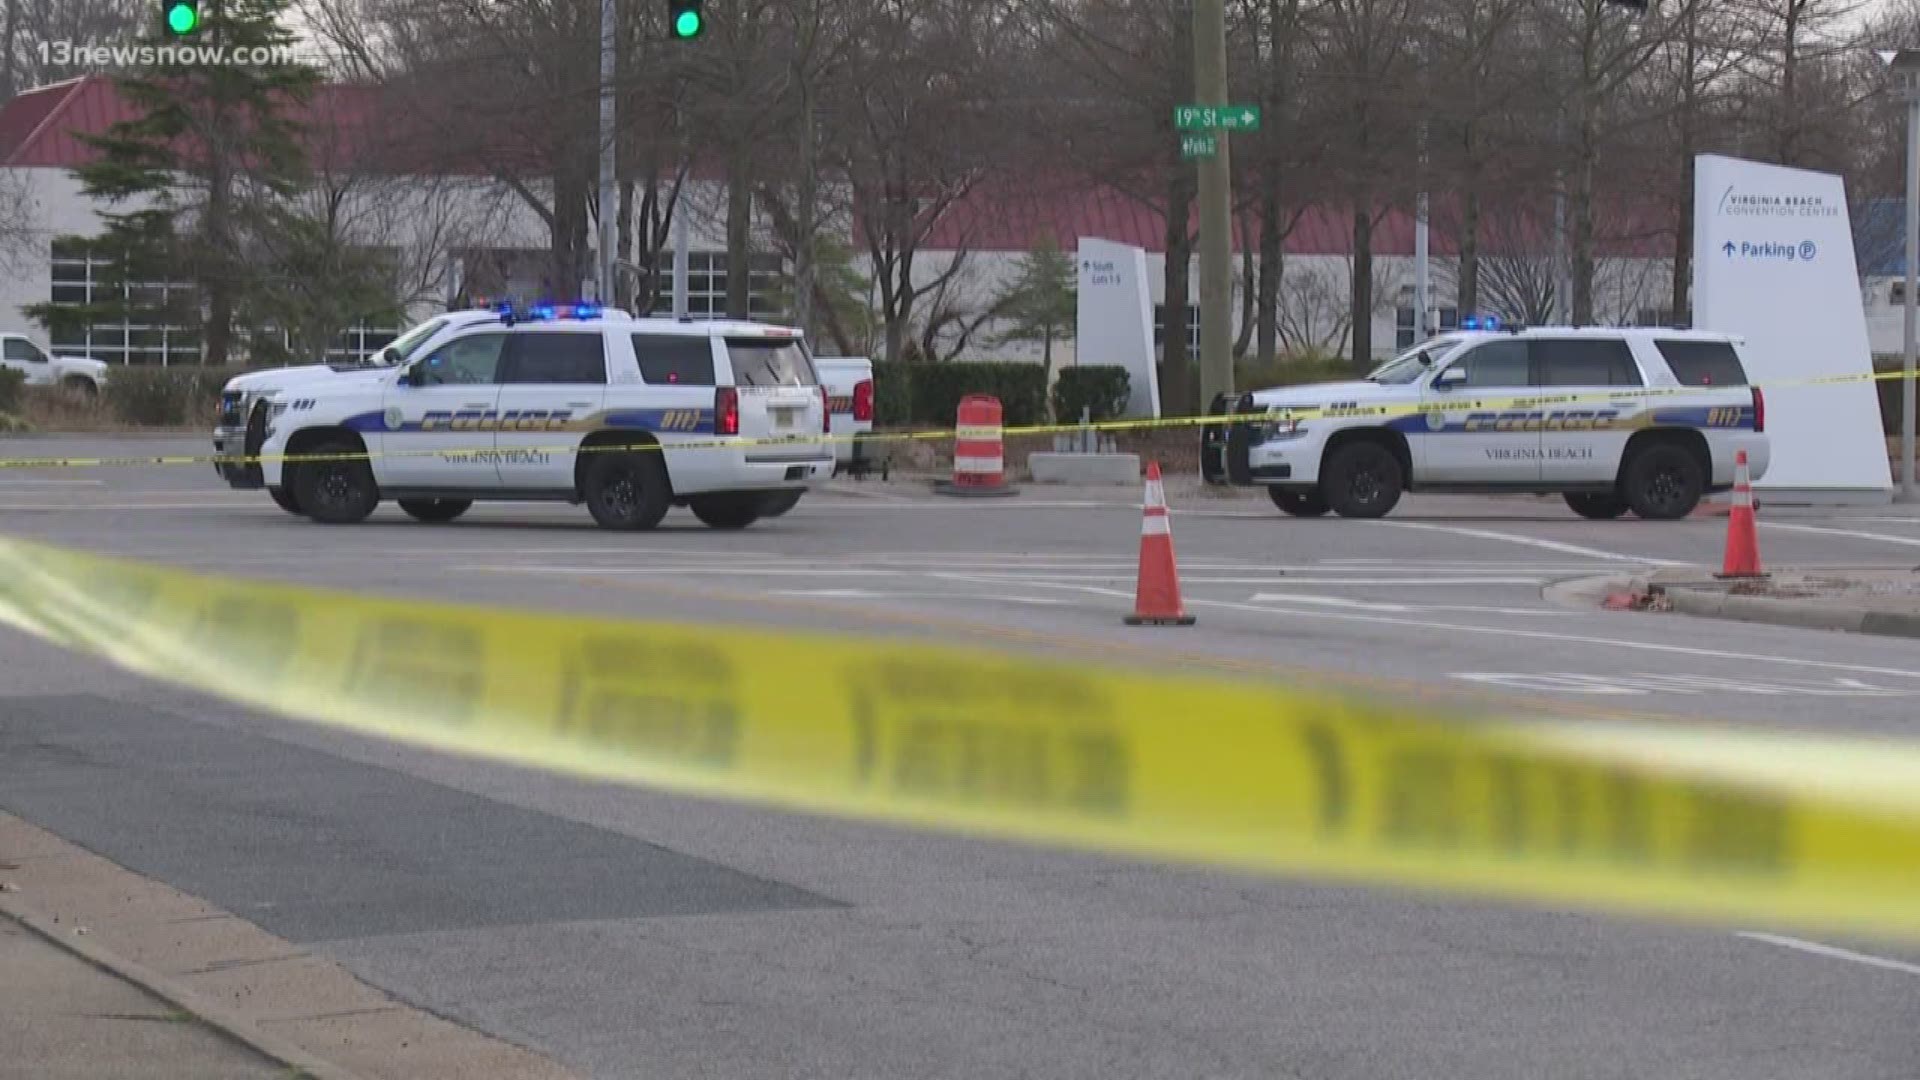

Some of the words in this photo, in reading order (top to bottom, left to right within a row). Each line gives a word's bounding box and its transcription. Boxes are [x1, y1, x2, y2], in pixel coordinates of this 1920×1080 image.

[1203, 107, 1217, 126] St
[1730, 196, 1781, 206] VIRGINIA
[1785, 196, 1822, 206] BEACH
[1725, 206, 1795, 217] CONVENTION
[1799, 207, 1839, 217] CENTER
[1741, 241, 1796, 260] Parking
[421, 409, 572, 432] POLICE
[1464, 411, 1618, 432] POLICE
[444, 450, 501, 464] VIRGINIA
[505, 449, 551, 465] BEACH
[1485, 448, 1545, 461] VIRGINIA
[1549, 447, 1593, 460] BEACH
